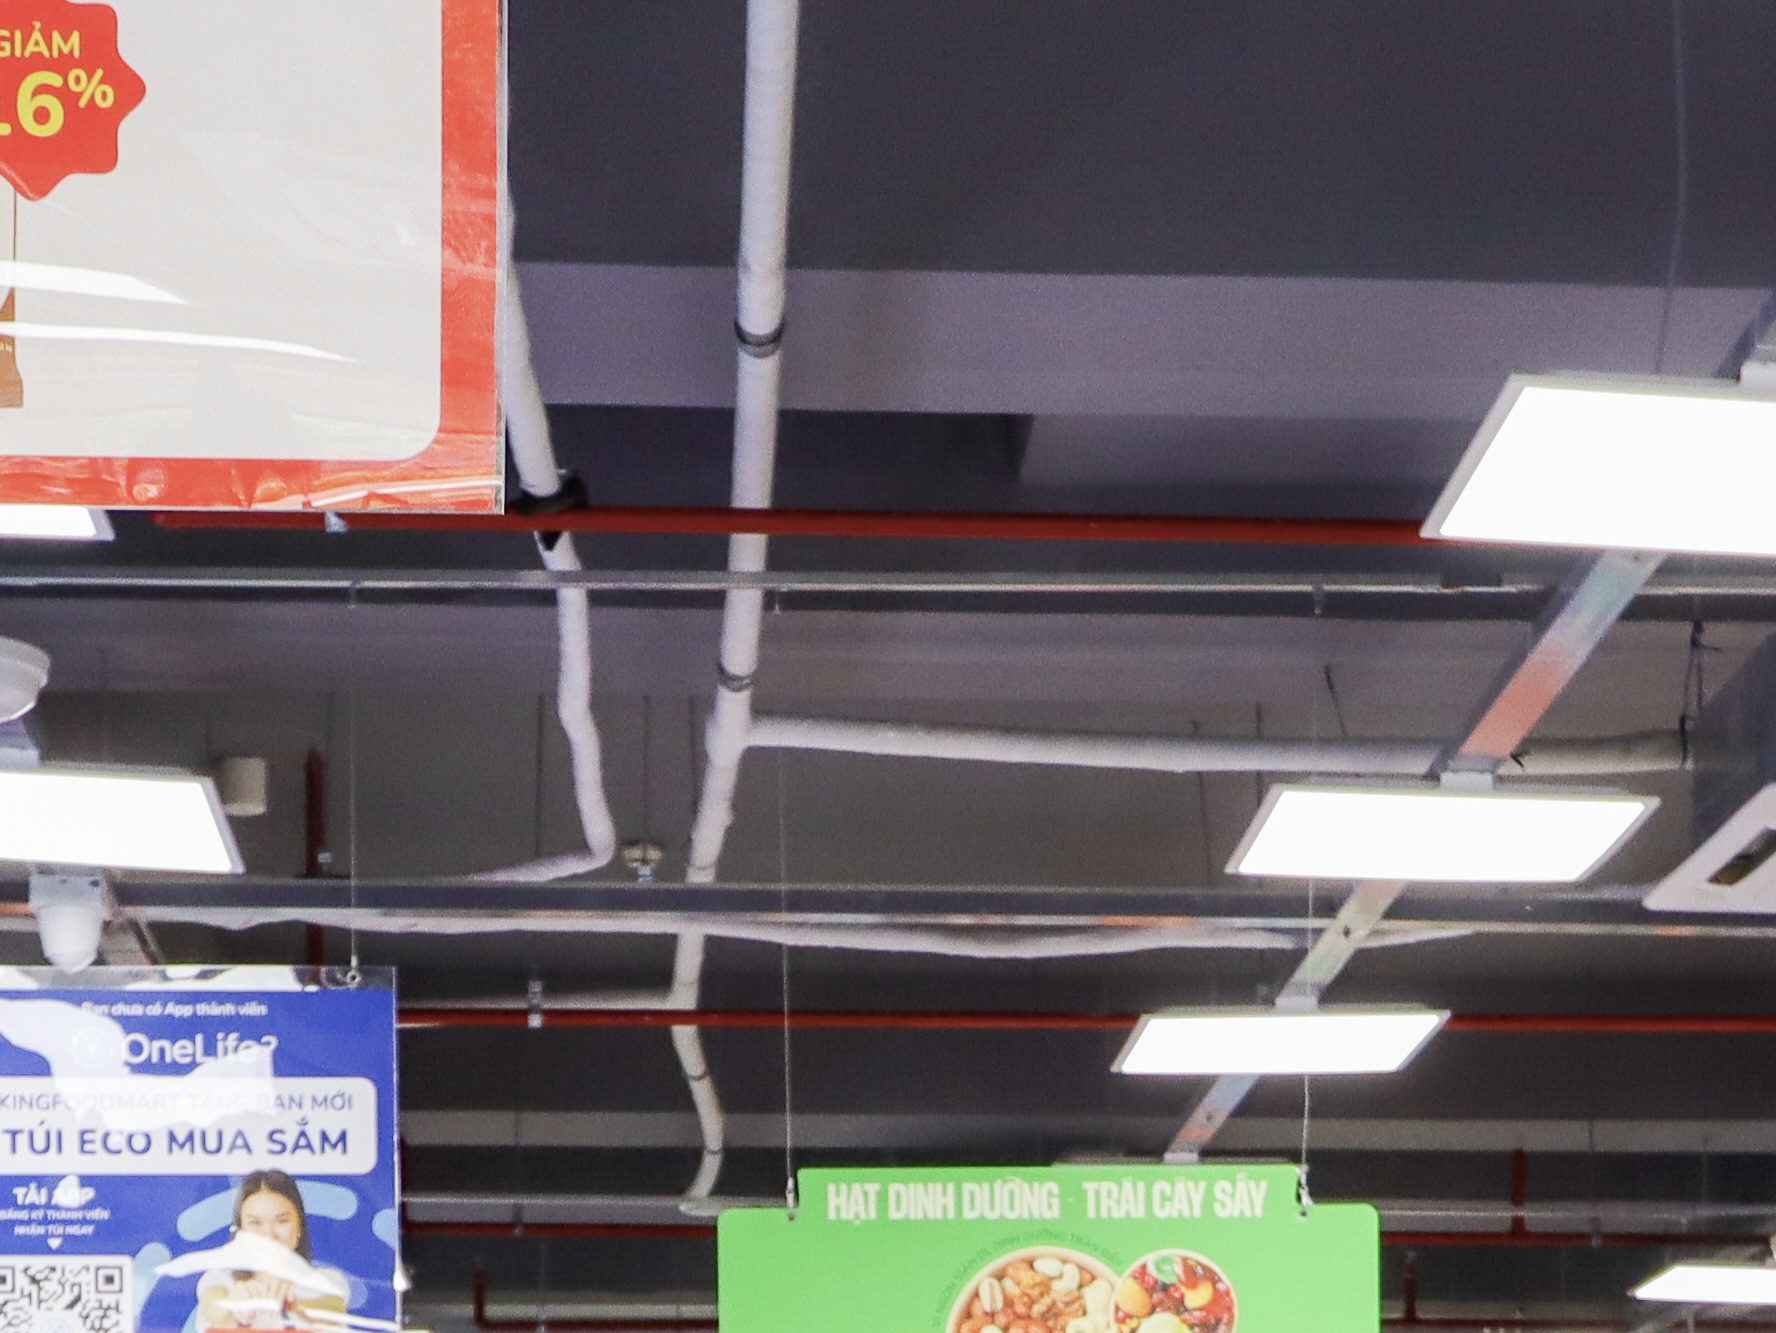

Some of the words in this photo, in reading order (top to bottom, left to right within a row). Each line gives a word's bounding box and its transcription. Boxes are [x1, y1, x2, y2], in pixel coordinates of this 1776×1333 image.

[2, 1120, 63, 1155] TÚI
[79, 1129, 152, 1155] ECO
[168, 1129, 252, 1155] MUA
[266, 1118, 348, 1155] SẮM
[827, 1182, 880, 1227] HẠT
[887, 1182, 957, 1220] DINH
[1152, 1175, 1207, 1219] CÂY
